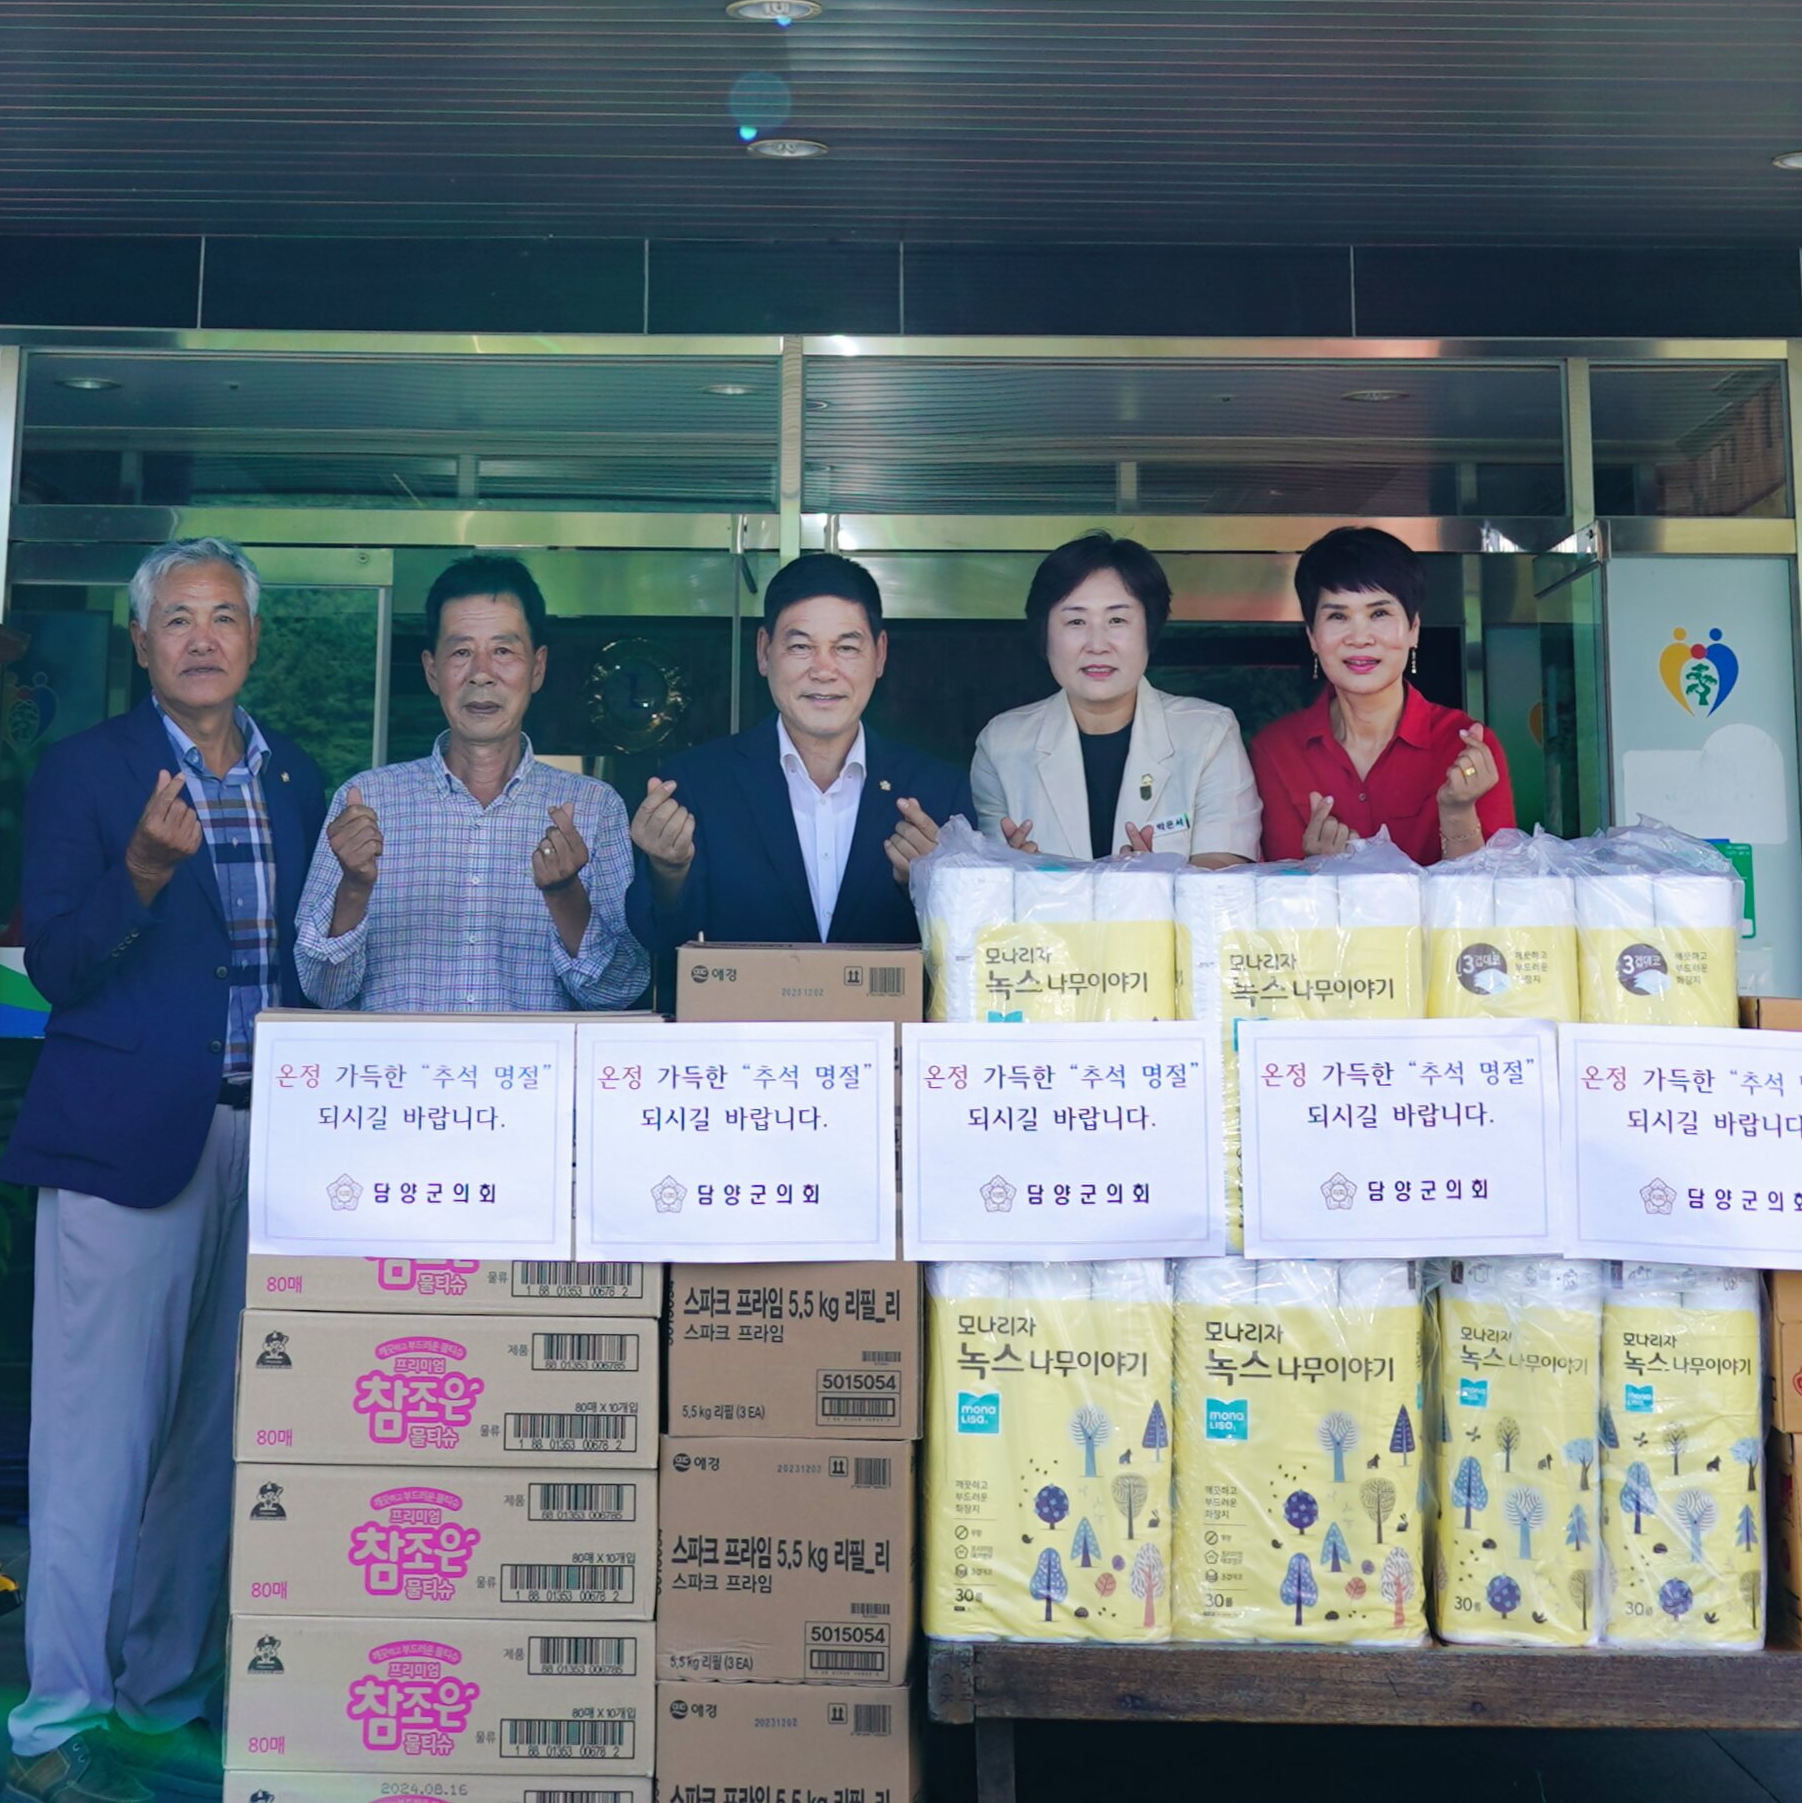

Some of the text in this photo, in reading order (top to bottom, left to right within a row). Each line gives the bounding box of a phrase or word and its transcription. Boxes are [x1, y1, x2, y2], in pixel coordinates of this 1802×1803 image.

[985, 946, 1052, 965] 모나리자
[1229, 952, 1297, 972] 모나리자
[712, 968, 737, 982] 애경
[985, 971, 1148, 1000] 녹스 나무이야기
[1293, 977, 1395, 1002] 나무이야기
[276, 1064, 551, 1090] 온정 가득한 “추석 명절”
[598, 1064, 871, 1090] 온정 가득한 “추석 명절”
[924, 1062, 1198, 1089] 온정 가득한 “추석 명절”
[1261, 1059, 1534, 1087] 온정 가득한 “추석 명절”
[1581, 1066, 1626, 1091] 온정
[1644, 1068, 1714, 1093] 가득한
[1730, 1070, 1784, 1097] “추석
[319, 1105, 504, 1131] 되시길 바랍니다.
[642, 1106, 827, 1131] 되시길 바랍니다.
[969, 1106, 1155, 1131] 되시길 바랍니다.
[1308, 1102, 1493, 1128] 되시길 바랍니다.
[1628, 1109, 1697, 1135] 되시길
[374, 1183, 495, 1204] 담양군의회
[698, 1184, 819, 1206] 담양군의회
[1028, 1183, 1149, 1205] 담양군의회
[1368, 1179, 1487, 1202] 담양군의회
[266, 1276, 303, 1293] 80매
[417, 1274, 468, 1296] 물티슈
[683, 1286, 731, 1318] 스파크
[736, 1287, 783, 1319] 프라임
[819, 1290, 839, 1322] kg
[845, 1289, 900, 1323] 리필_리
[683, 1323, 784, 1342] 스파크 프라임
[956, 1314, 1037, 1339] 모나리자
[1204, 1322, 1284, 1345] 모나리자
[1460, 1326, 1512, 1343] 모나리자
[1622, 1332, 1678, 1348] 모나리자
[393, 1358, 446, 1374] 프리미엄
[957, 1344, 1148, 1381] 녹스 나무이야기
[1204, 1349, 1395, 1386] 녹스 나무이야기
[1460, 1346, 1589, 1375] 녹스 나무이야기
[1623, 1350, 1752, 1377] 녹스 나무이야기
[822, 1374, 896, 1390] 5015054
[358, 1374, 482, 1441] 참조은
[574, 1402, 597, 1414] 80매
[699, 1405, 712, 1420] kg
[714, 1405, 734, 1420] 리필
[257, 1429, 293, 1447] 80매
[408, 1426, 459, 1450] 물티슈
[694, 1457, 720, 1471] 애경
[389, 1509, 442, 1525] 프리미엄
[352, 1524, 478, 1593] 참조은
[571, 1552, 594, 1564] 80매
[671, 1534, 719, 1567] 스파크
[724, 1536, 772, 1569] 프라임
[808, 1541, 828, 1572] kg
[834, 1538, 890, 1574] 리필_리
[251, 1581, 288, 1599] 80매
[404, 1577, 456, 1601] 물티슈
[672, 1573, 773, 1593] 스파크 프라임
[811, 1626, 885, 1643] 5015054
[388, 1662, 440, 1679] 프리미엄
[702, 1655, 722, 1670] 리필
[351, 1678, 476, 1747] 참조은
[571, 1707, 594, 1719] 80매
[691, 1704, 717, 1718] 애경
[248, 1736, 285, 1755] 80매
[402, 1732, 455, 1756] 물티슈
[380, 1783, 467, 1796] 2024.08.16
